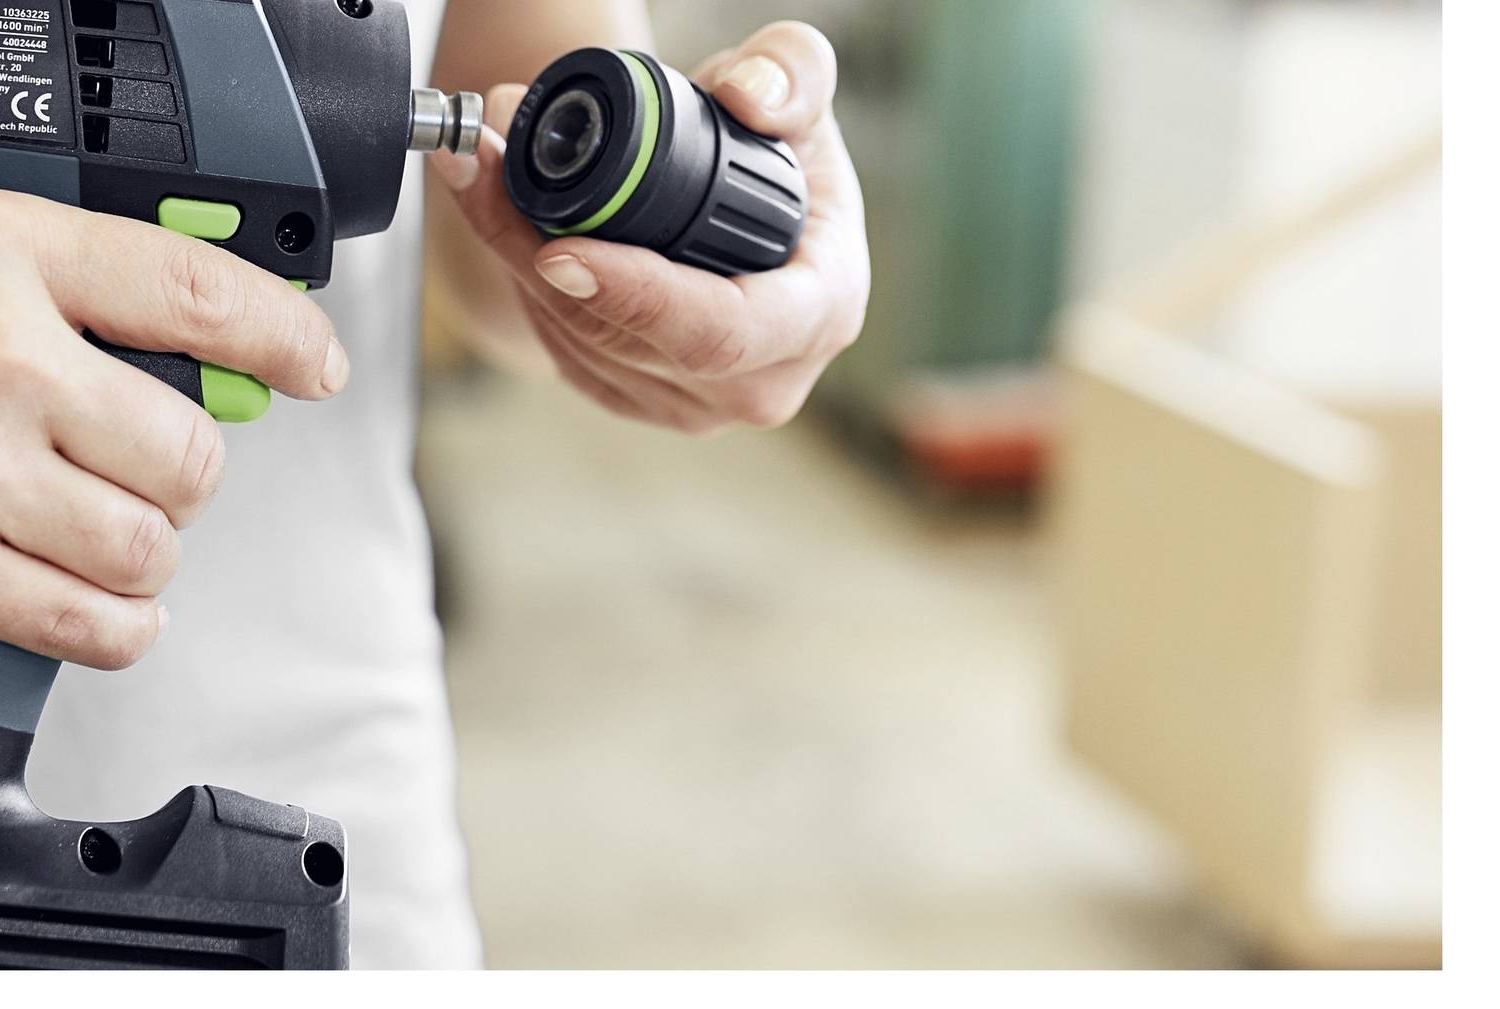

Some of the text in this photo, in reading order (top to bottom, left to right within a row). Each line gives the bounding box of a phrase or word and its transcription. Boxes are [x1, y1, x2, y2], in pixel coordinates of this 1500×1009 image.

[3, 8, 50, 20] 10363225
[3, 37, 47, 49] 40024448
[7, 52, 35, 62] GmbH
[10, 63, 22, 72] 20
[0, 73, 53, 86] Wendlingen
[11, 91, 52, 122] CE
[18, 123, 58, 134] Republic
